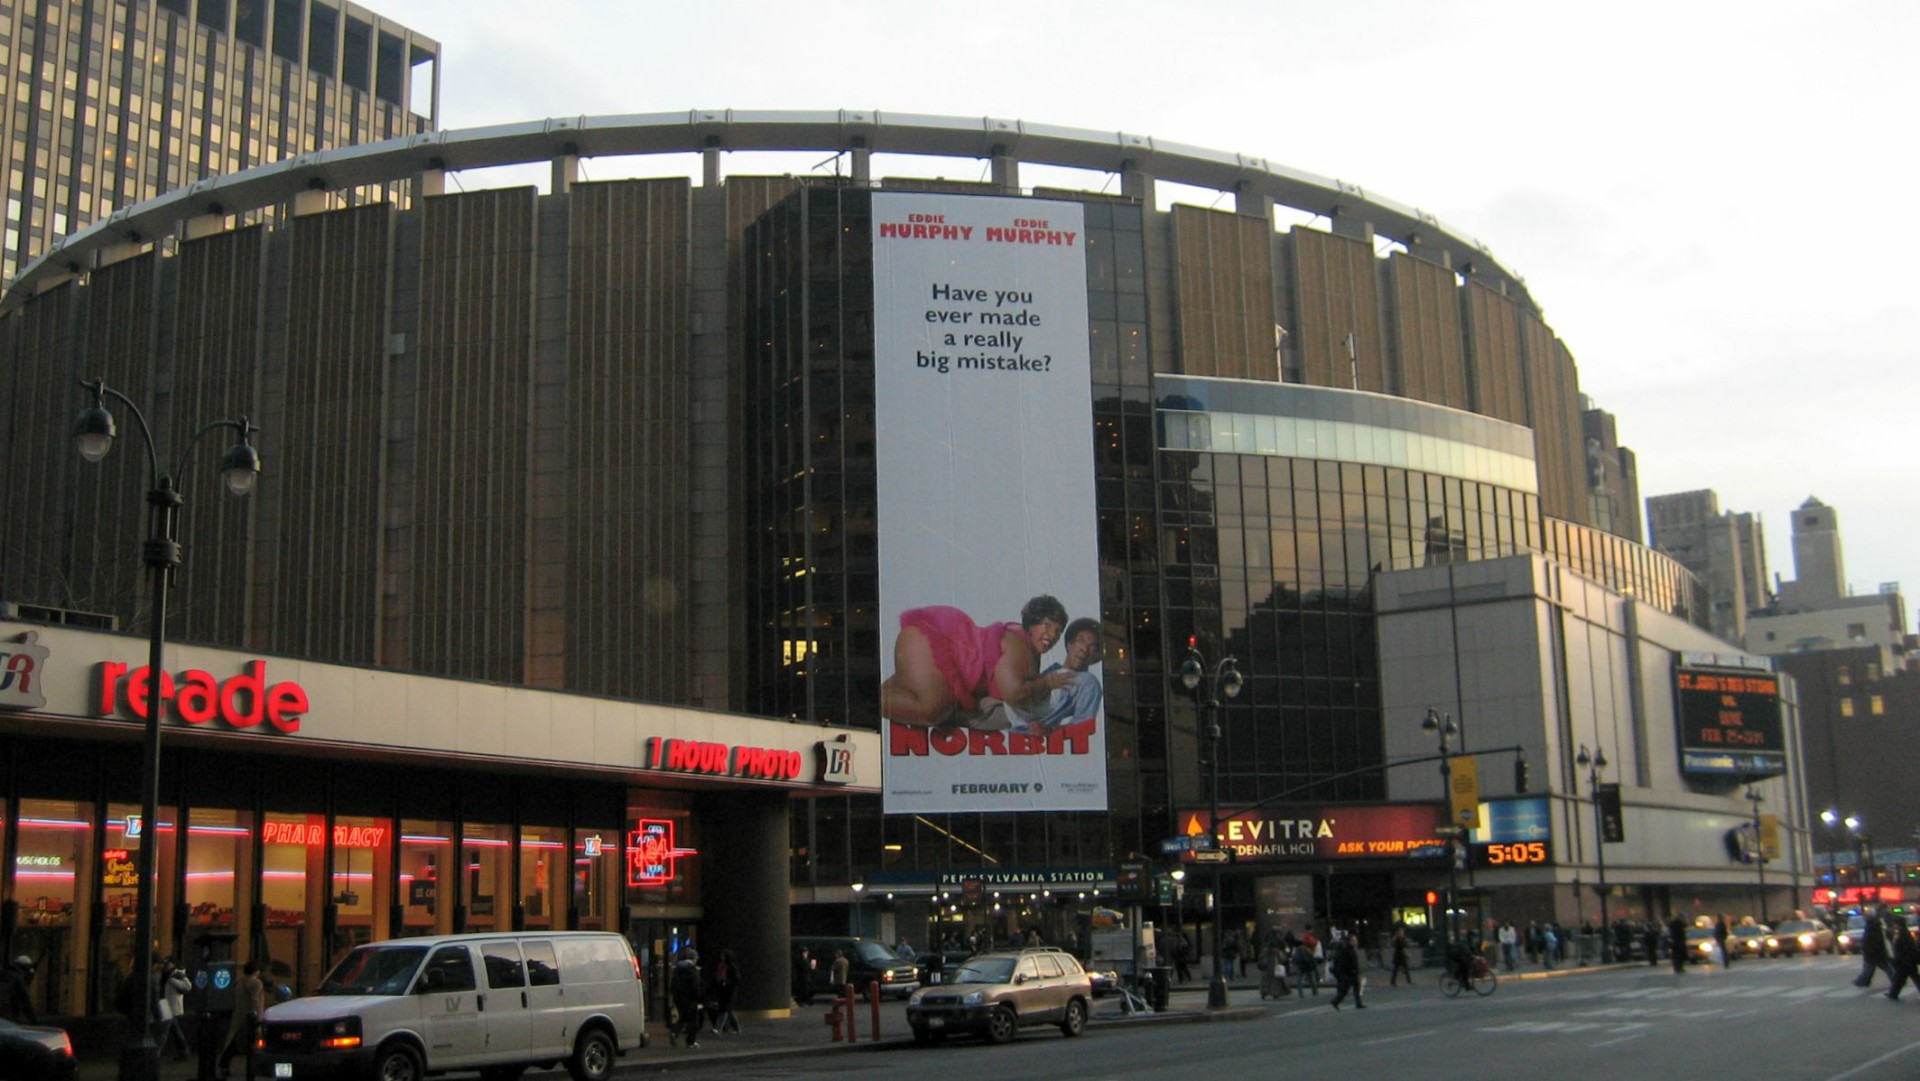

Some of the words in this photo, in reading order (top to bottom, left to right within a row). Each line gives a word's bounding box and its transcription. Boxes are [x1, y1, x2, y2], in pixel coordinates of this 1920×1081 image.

[908, 213, 945, 224] EDDIE
[1014, 218, 1049, 229] EDDIE
[880, 223, 974, 241] MURPHY
[986, 227, 1077, 246] MURPHY
[932, 283, 988, 302] Have
[995, 290, 1033, 307] you
[925, 310, 972, 324] ever
[980, 309, 1041, 326] made
[944, 333, 956, 346] a
[964, 331, 1023, 353] really
[916, 350, 949, 374] big
[957, 353, 1052, 372] mistake?
[102, 660, 309, 733] reade
[890, 718, 1096, 757] NORBIT
[651, 737, 663, 767] 1
[668, 738, 728, 774] HOUR
[736, 746, 802, 780] PHOTO
[952, 783, 1029, 796] FEBRUARY
[1034, 783, 1044, 794] 9
[264, 821, 385, 847] PHARMACY
[1338, 842, 1364, 853] ASK
[1369, 841, 1404, 852] YOUR
[1488, 842, 1546, 865] 5:05
[1051, 872, 1104, 882] STATION
